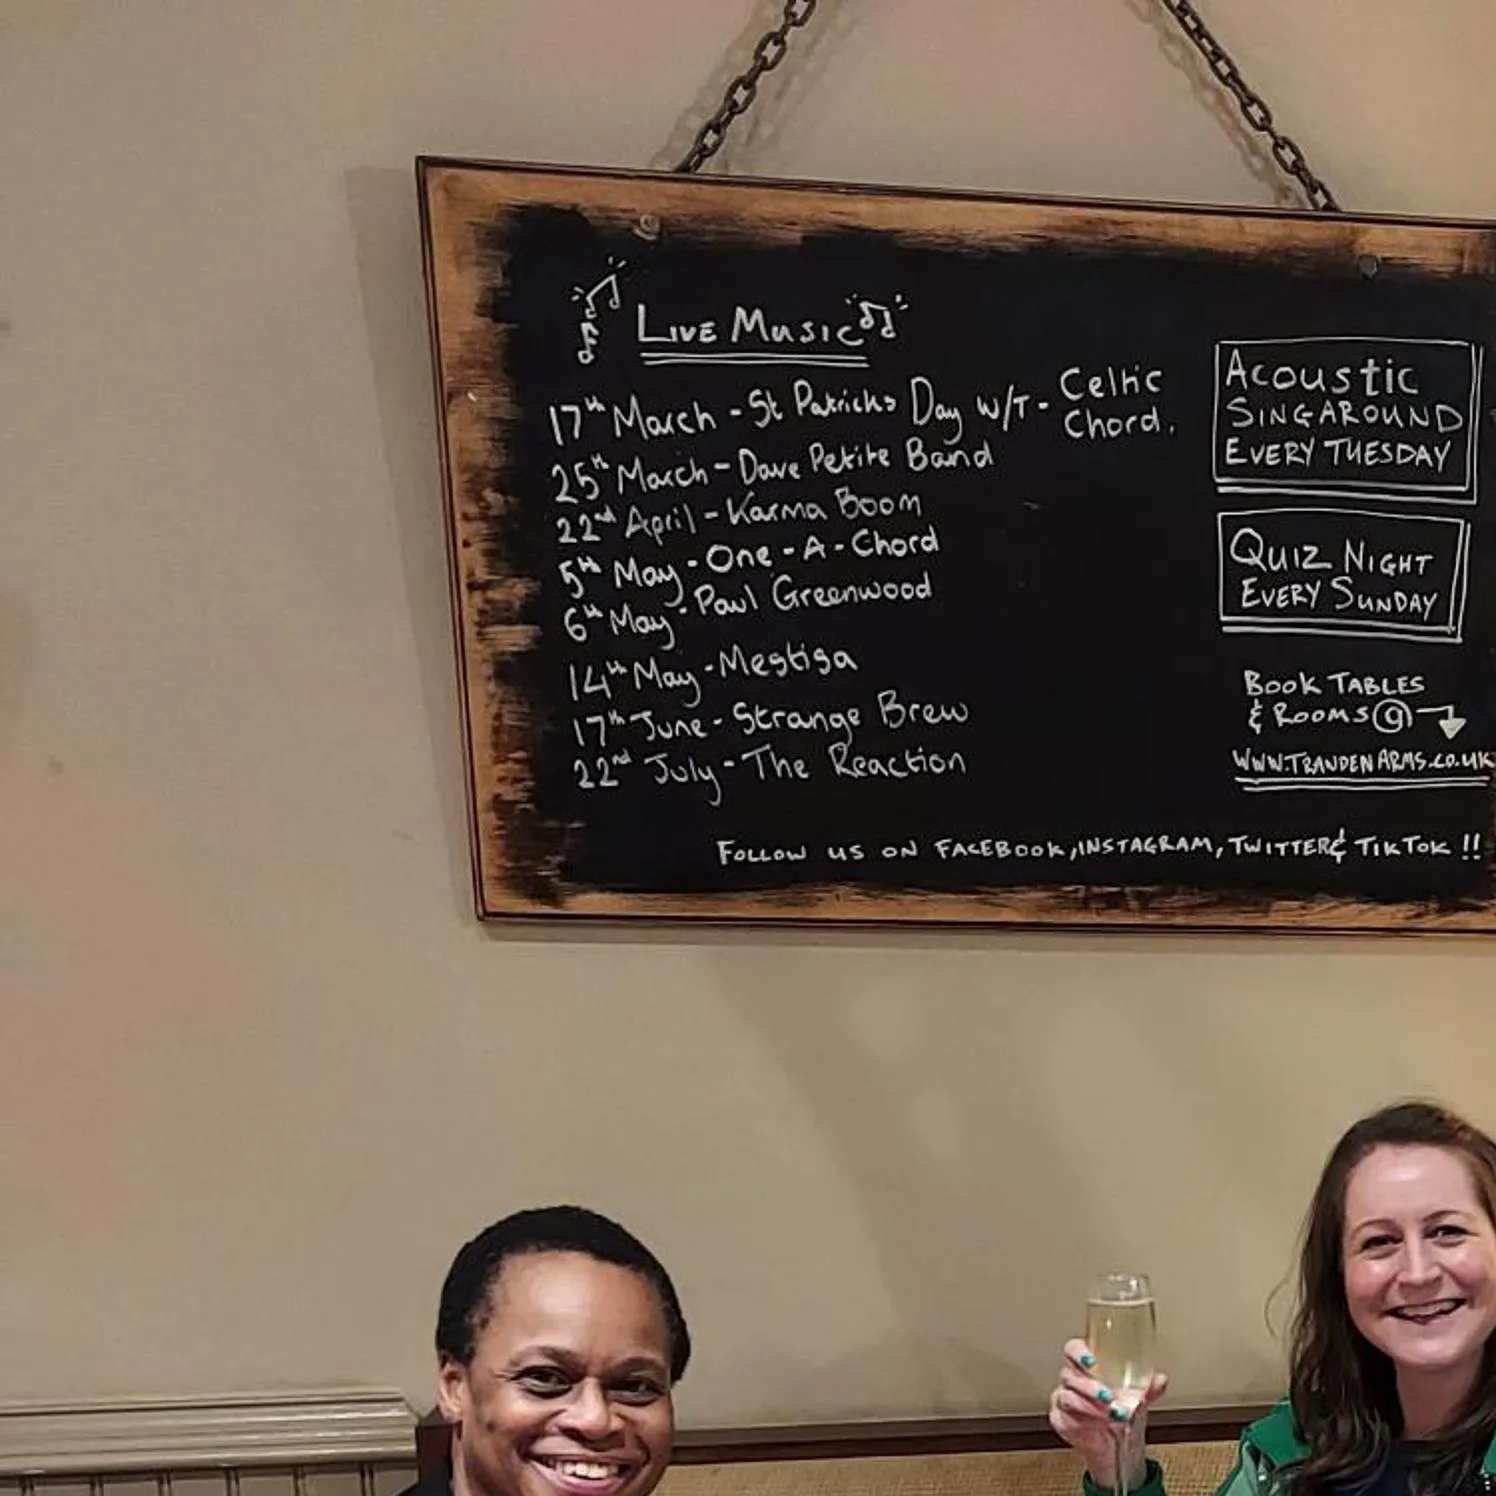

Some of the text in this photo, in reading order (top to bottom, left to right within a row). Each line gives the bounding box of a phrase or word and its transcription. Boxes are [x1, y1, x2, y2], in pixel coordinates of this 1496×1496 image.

[614, 395, 716, 439] March
[749, 389, 782, 427] St
[794, 380, 896, 417] Patricks
[908, 377, 962, 446] Day
[1227, 397, 1462, 432] SINGAROUND
[618, 457, 708, 494] March
[739, 448, 800, 484] Dave
[906, 434, 993, 471] Band
[1226, 437, 1450, 471] EVERY TUESDAY
[626, 504, 695, 545] April
[727, 491, 827, 524] Karma
[835, 487, 920, 518] Boom
[1230, 528, 1433, 576] QUIZ NIGHT
[614, 557, 683, 607] May
[1242, 576, 1437, 622] EVERY SUNDAY
[610, 603, 674, 650] May
[694, 584, 758, 615] Paul
[773, 572, 931, 610] Greenwood
[634, 658, 700, 707] May
[1244, 670, 1424, 695] BOOK TABLES
[630, 711, 706, 740] June
[733, 702, 860, 750] Strange
[878, 690, 967, 728] Brew
[1273, 702, 1368, 727] ROOMS
[644, 754, 720, 805] July
[742, 744, 808, 779] The
[829, 740, 965, 778] Reaction
[717, 840, 806, 864] FOLLOW
